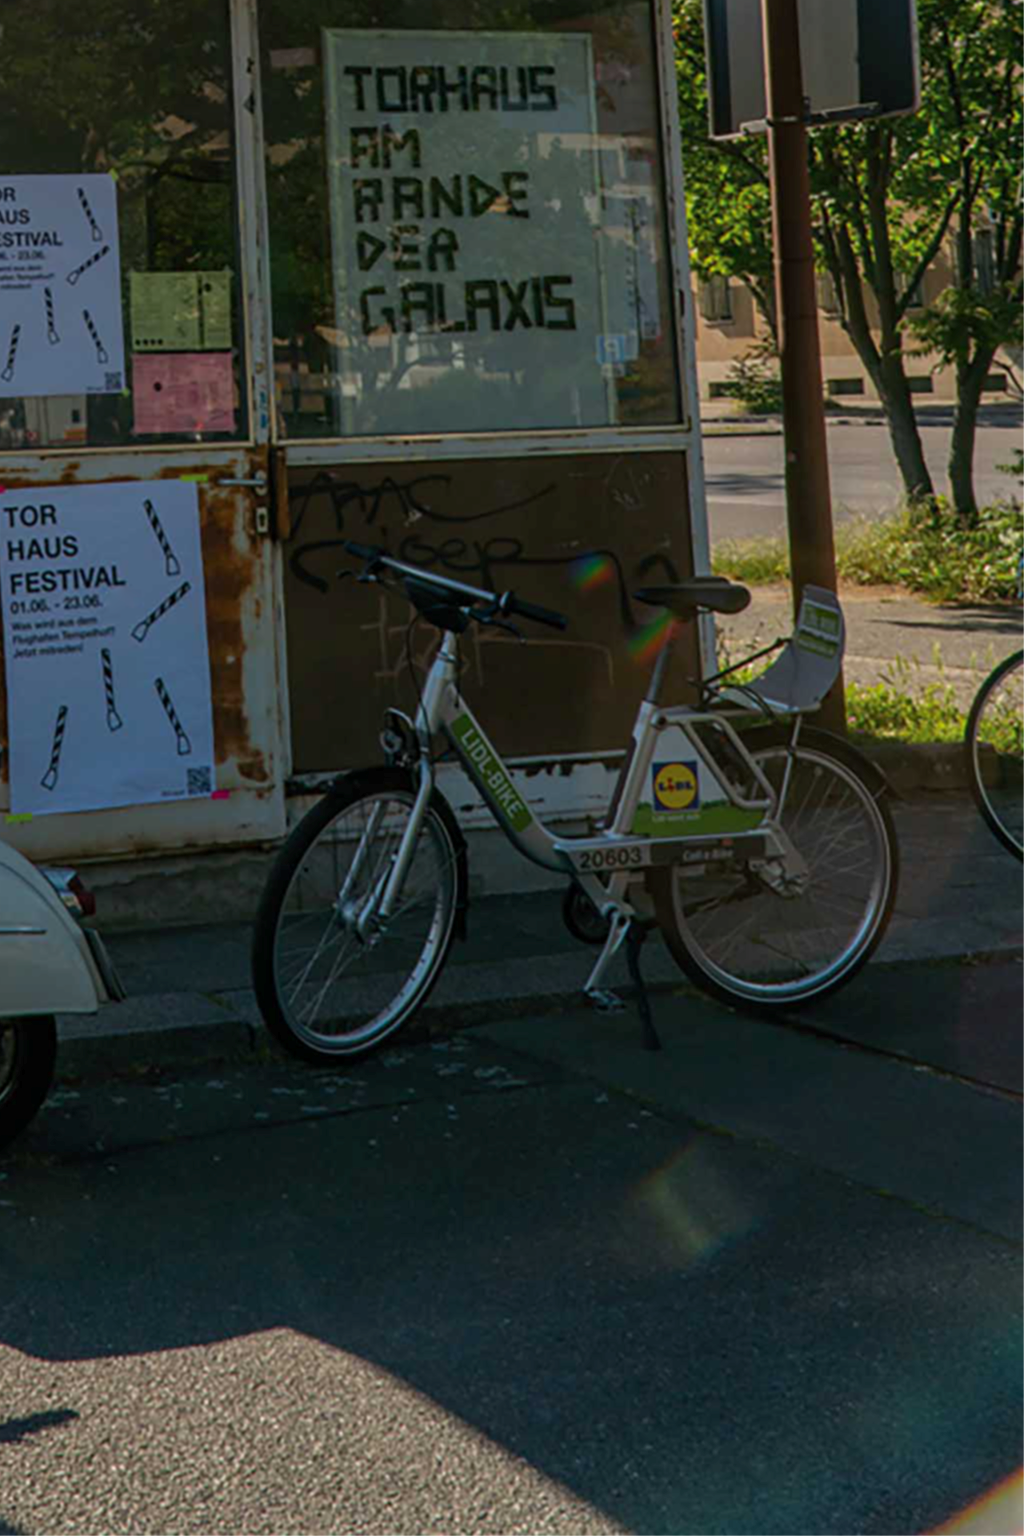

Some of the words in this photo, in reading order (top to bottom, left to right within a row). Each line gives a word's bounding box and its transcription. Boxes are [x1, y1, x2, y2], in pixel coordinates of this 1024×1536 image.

[344, 65, 558, 113] TORHAUS
[349, 124, 421, 169] AM
[353, 171, 530, 223] RANDE
[356, 225, 459, 272] DER
[360, 275, 576, 334] GALAXIS
[4, 504, 57, 528] TOR
[7, 535, 79, 561] HAUS
[10, 565, 126, 595] FESTIVAL
[10, 599, 51, 615] 01.06.
[63, 594, 103, 611] 23.06.
[12, 622, 32, 631] Was
[34, 619, 55, 630] wird
[58, 619, 74, 628] aus
[77, 616, 98, 626] dem
[12, 633, 60, 646] Flughafen
[13, 648, 37, 659] Jetzt
[461, 728, 523, 819] LIDL-BIKE
[579, 846, 642, 869] 20603
